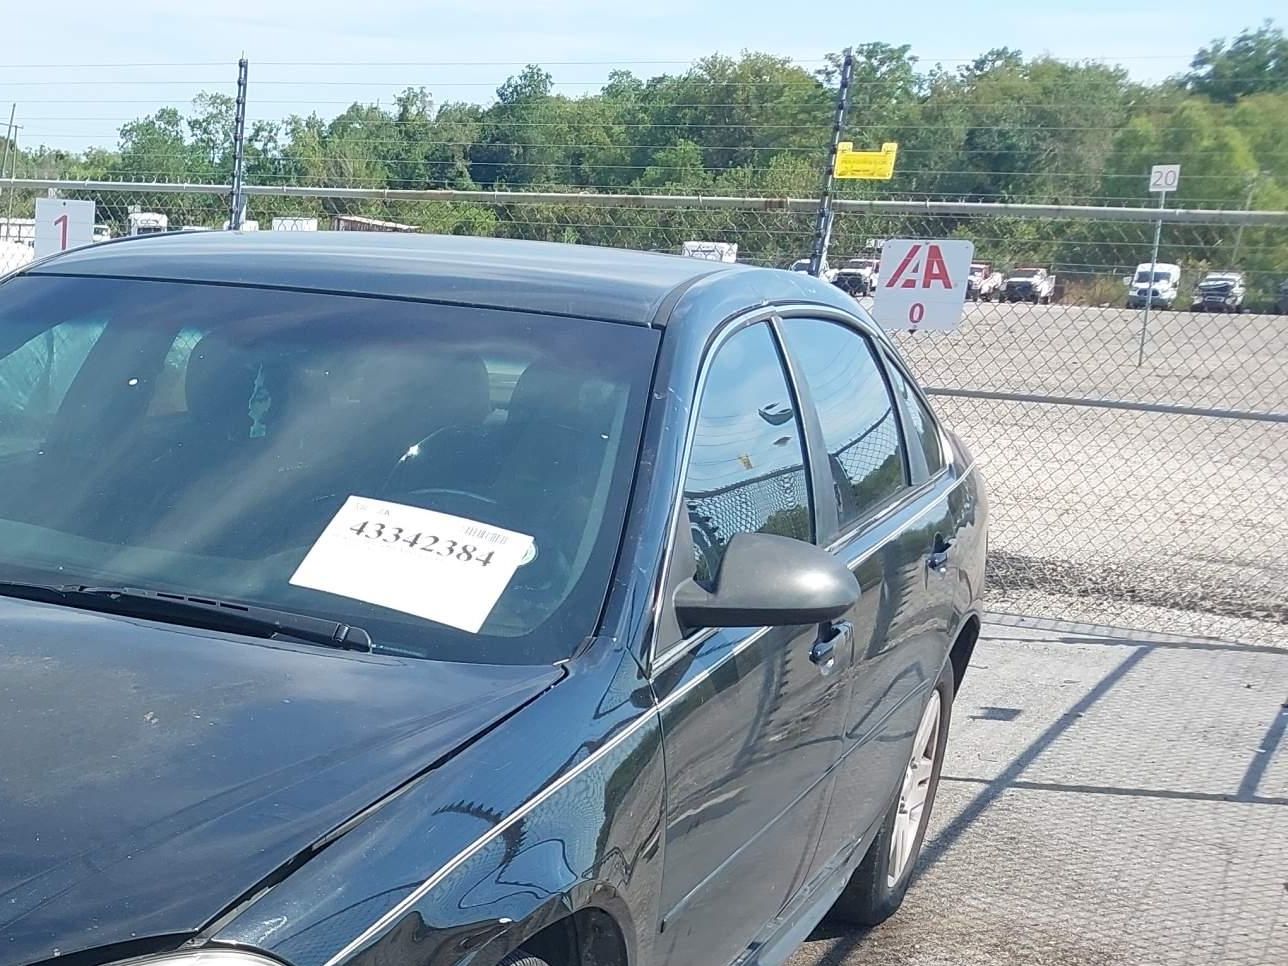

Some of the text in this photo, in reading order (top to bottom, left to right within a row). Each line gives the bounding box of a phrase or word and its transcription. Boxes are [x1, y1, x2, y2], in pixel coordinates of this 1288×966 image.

[1152, 170, 1177, 187] 20
[54, 214, 68, 251] 1
[909, 302, 925, 324] 0
[349, 520, 495, 567] 43342384
